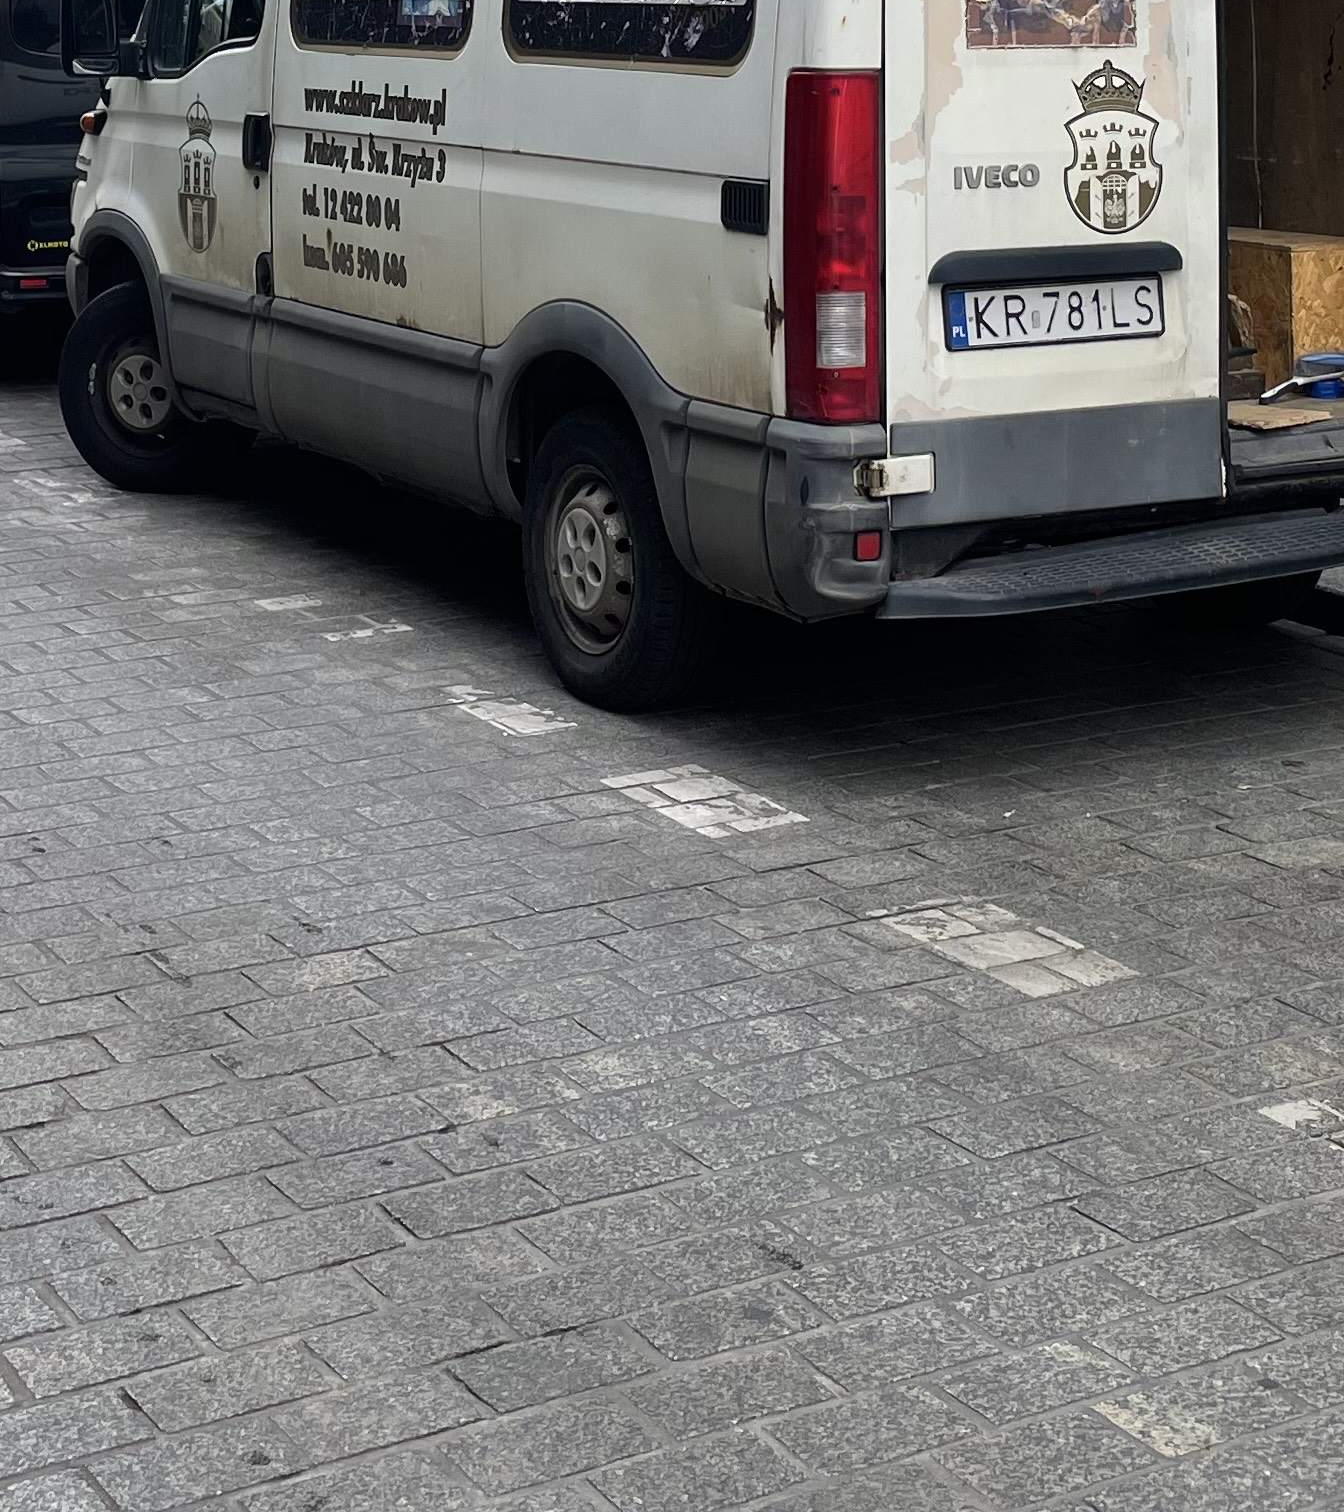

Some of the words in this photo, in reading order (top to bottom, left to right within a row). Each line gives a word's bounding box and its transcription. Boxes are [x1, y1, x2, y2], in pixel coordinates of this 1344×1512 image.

[303, 132, 349, 174] Kraków,
[351, 137, 364, 171] ul.
[391, 142, 434, 188] Krzyża
[436, 148, 446, 183] 3
[953, 163, 1041, 190] IVECO
[302, 183, 320, 217] tel.
[323, 187, 337, 220] 12
[340, 190, 363, 225] 422
[384, 196, 400, 232] 04
[357, 246, 380, 282] 590
[952, 325, 966, 338] PL
